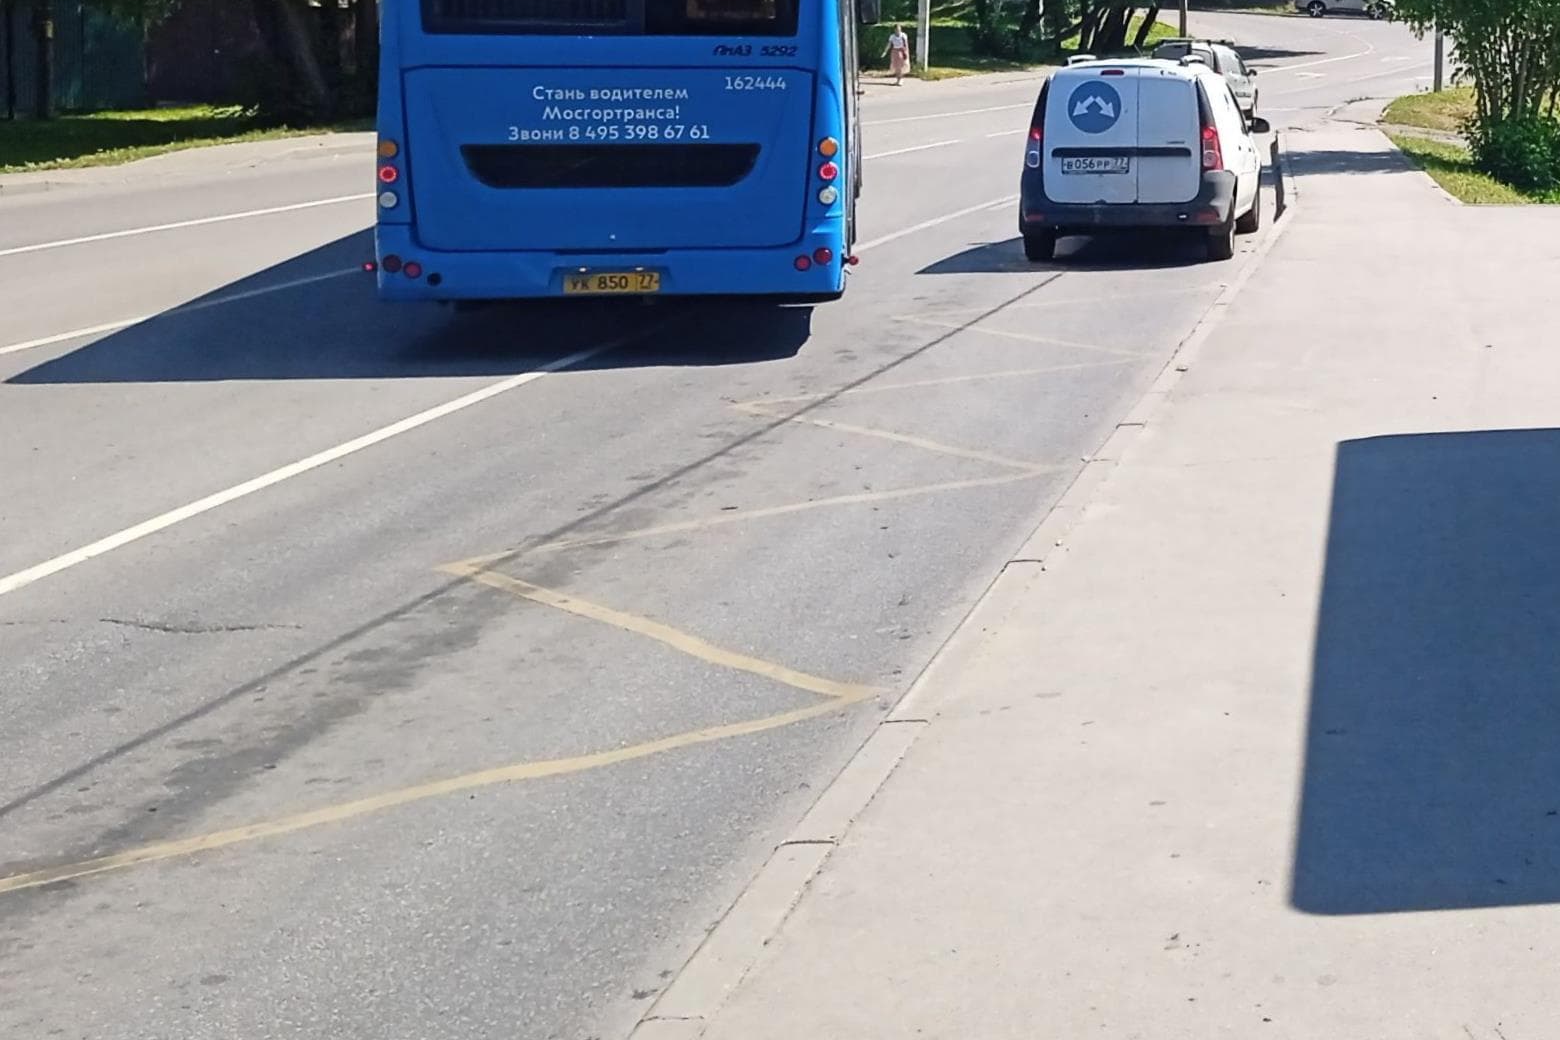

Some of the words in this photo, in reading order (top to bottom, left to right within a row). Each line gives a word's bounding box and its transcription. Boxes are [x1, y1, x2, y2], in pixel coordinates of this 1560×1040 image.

[760, 45, 798, 57] 5292
[724, 76, 786, 90] 162444
[532, 85, 586, 101] Стань
[590, 87, 689, 102] водителем
[542, 105, 681, 123] Мосгортранса!
[508, 126, 564, 141] Звони
[568, 126, 580, 140] 8
[585, 125, 620, 139] 495
[624, 125, 659, 140] 398
[663, 124, 685, 139] 67
[689, 124, 710, 139] 61
[598, 275, 629, 290] 850
